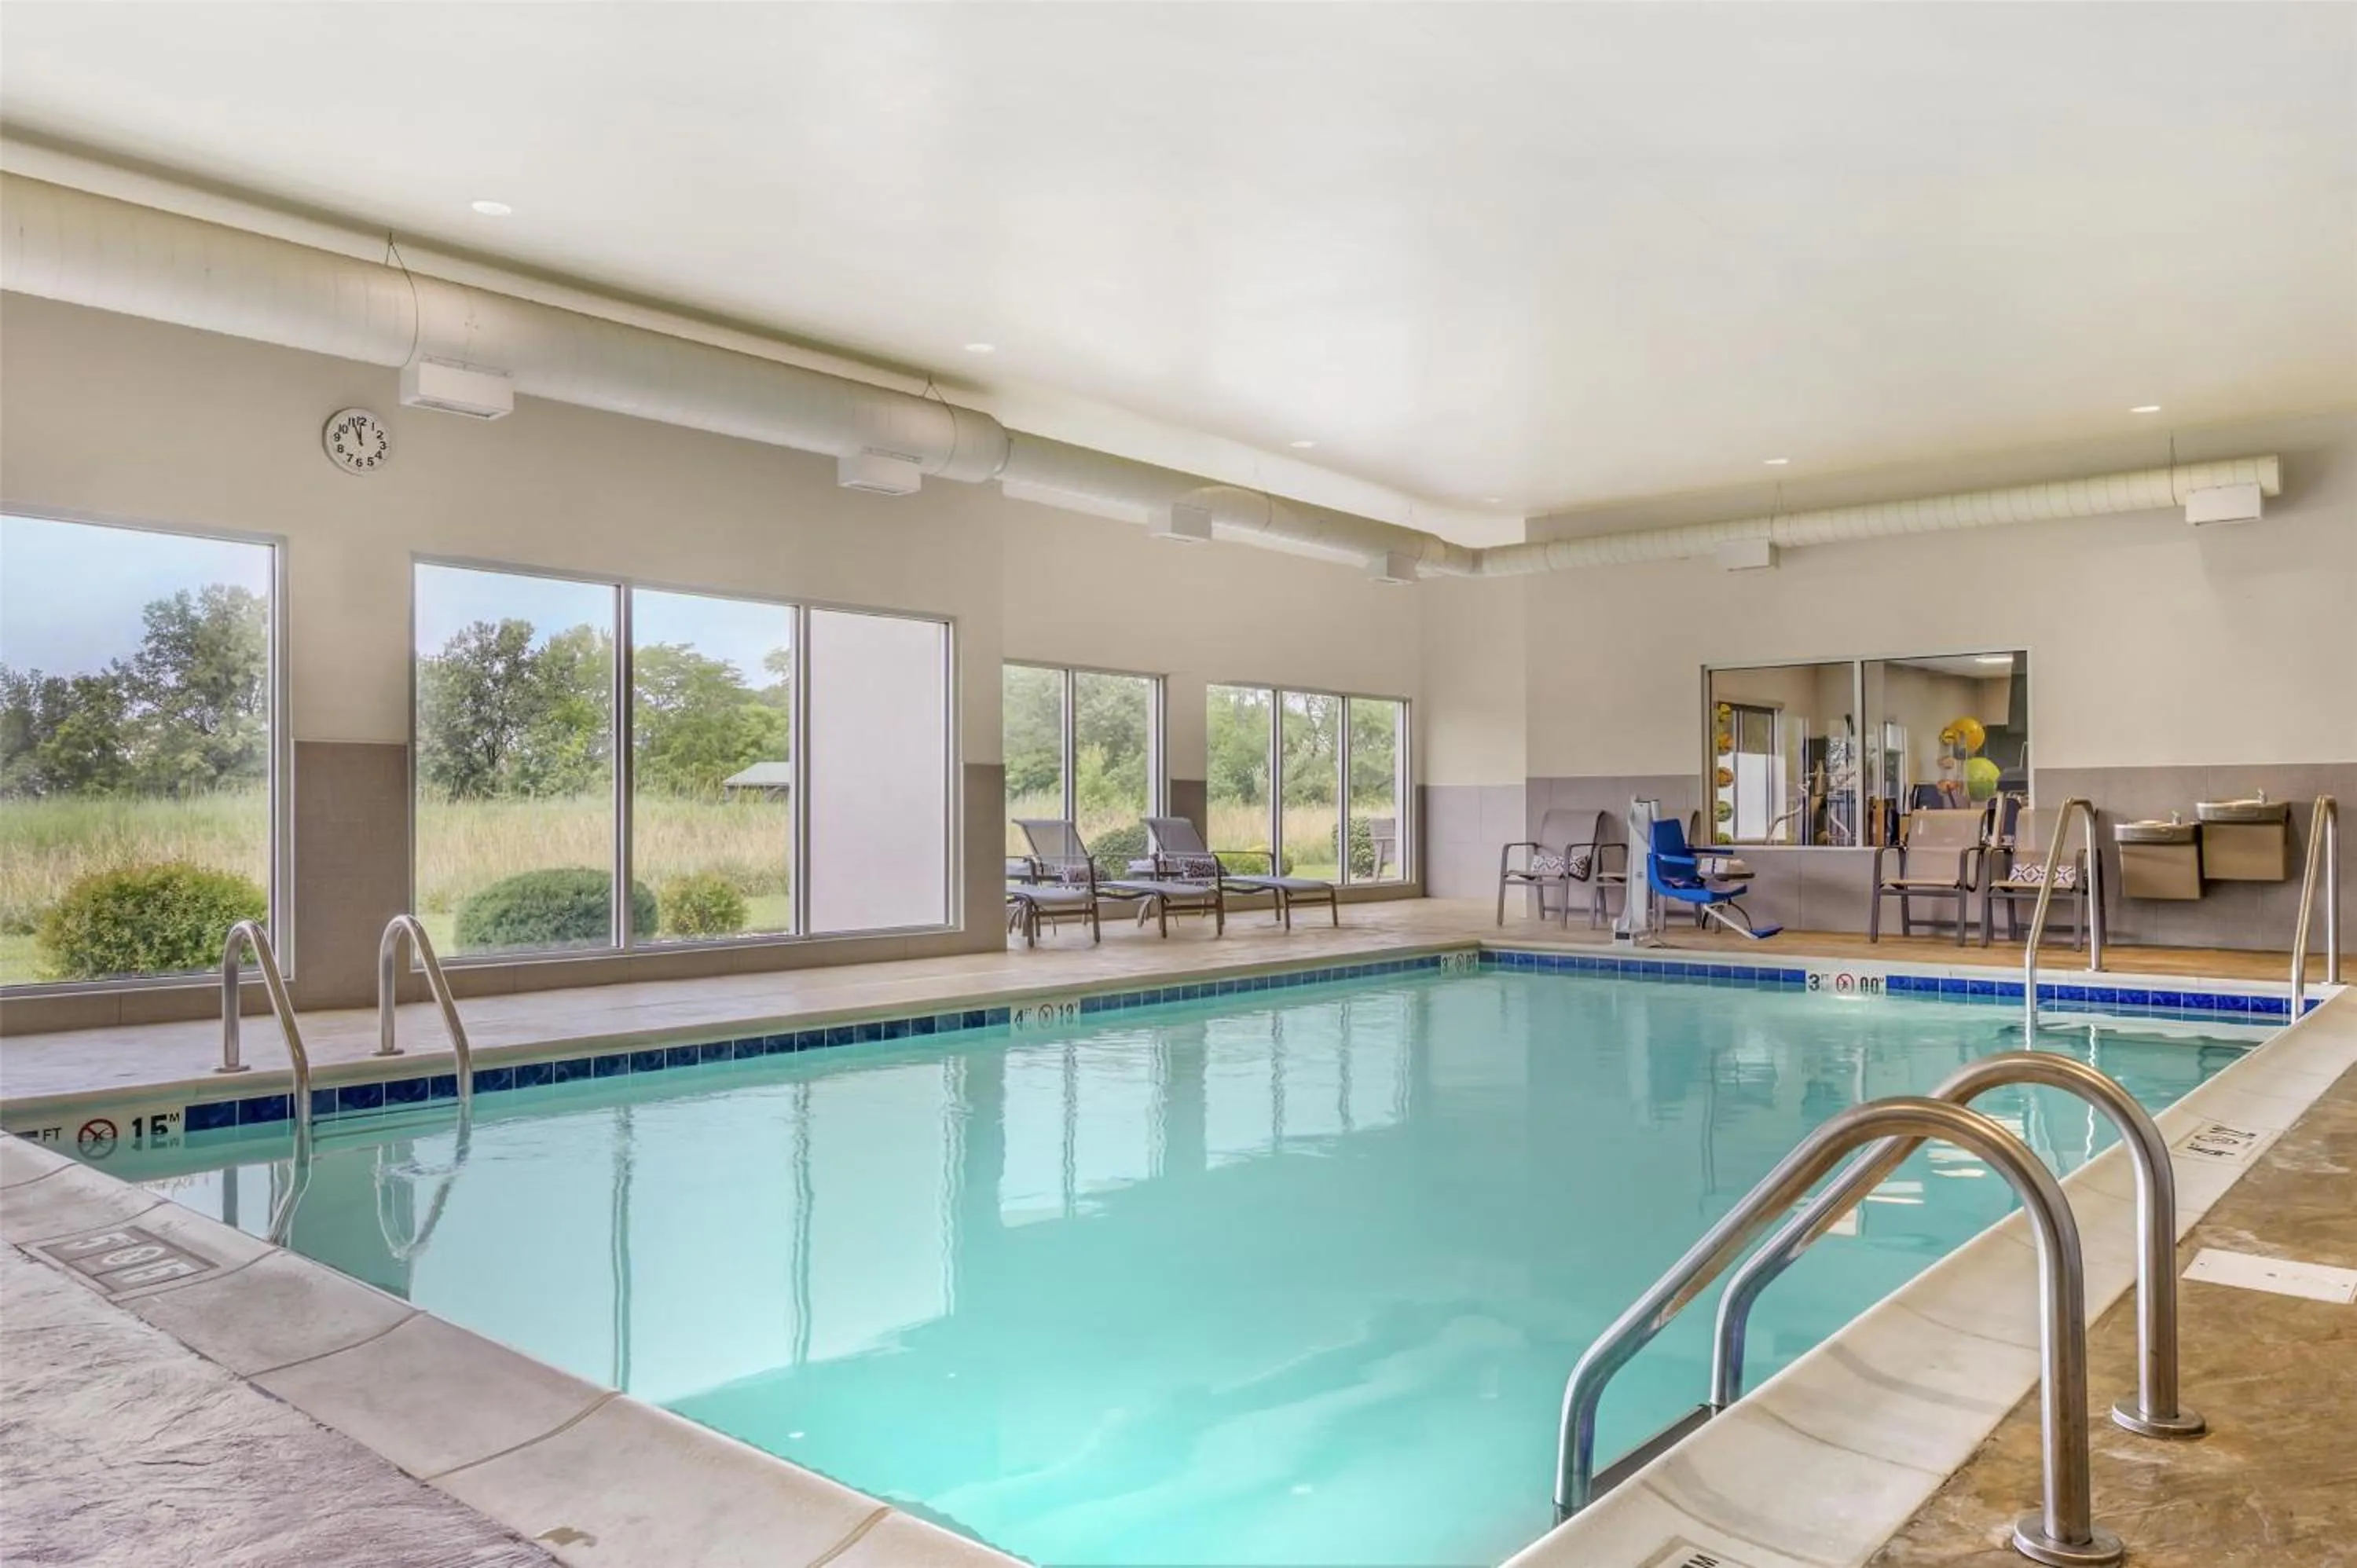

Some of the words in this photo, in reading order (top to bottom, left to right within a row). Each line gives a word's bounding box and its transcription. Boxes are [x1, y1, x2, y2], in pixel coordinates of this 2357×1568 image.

[348, 416, 356, 427] 11
[357, 416, 367, 427] 12
[371, 421, 375, 431] 1
[339, 423, 349, 434] 10
[333, 431, 341, 442] 9
[376, 430, 384, 440] 2
[337, 444, 345, 453] 8
[379, 441, 387, 450] 3
[346, 452, 354, 463] 7
[374, 450, 383, 460] 4
[356, 458, 364, 467] 6
[367, 456, 375, 467] 5
